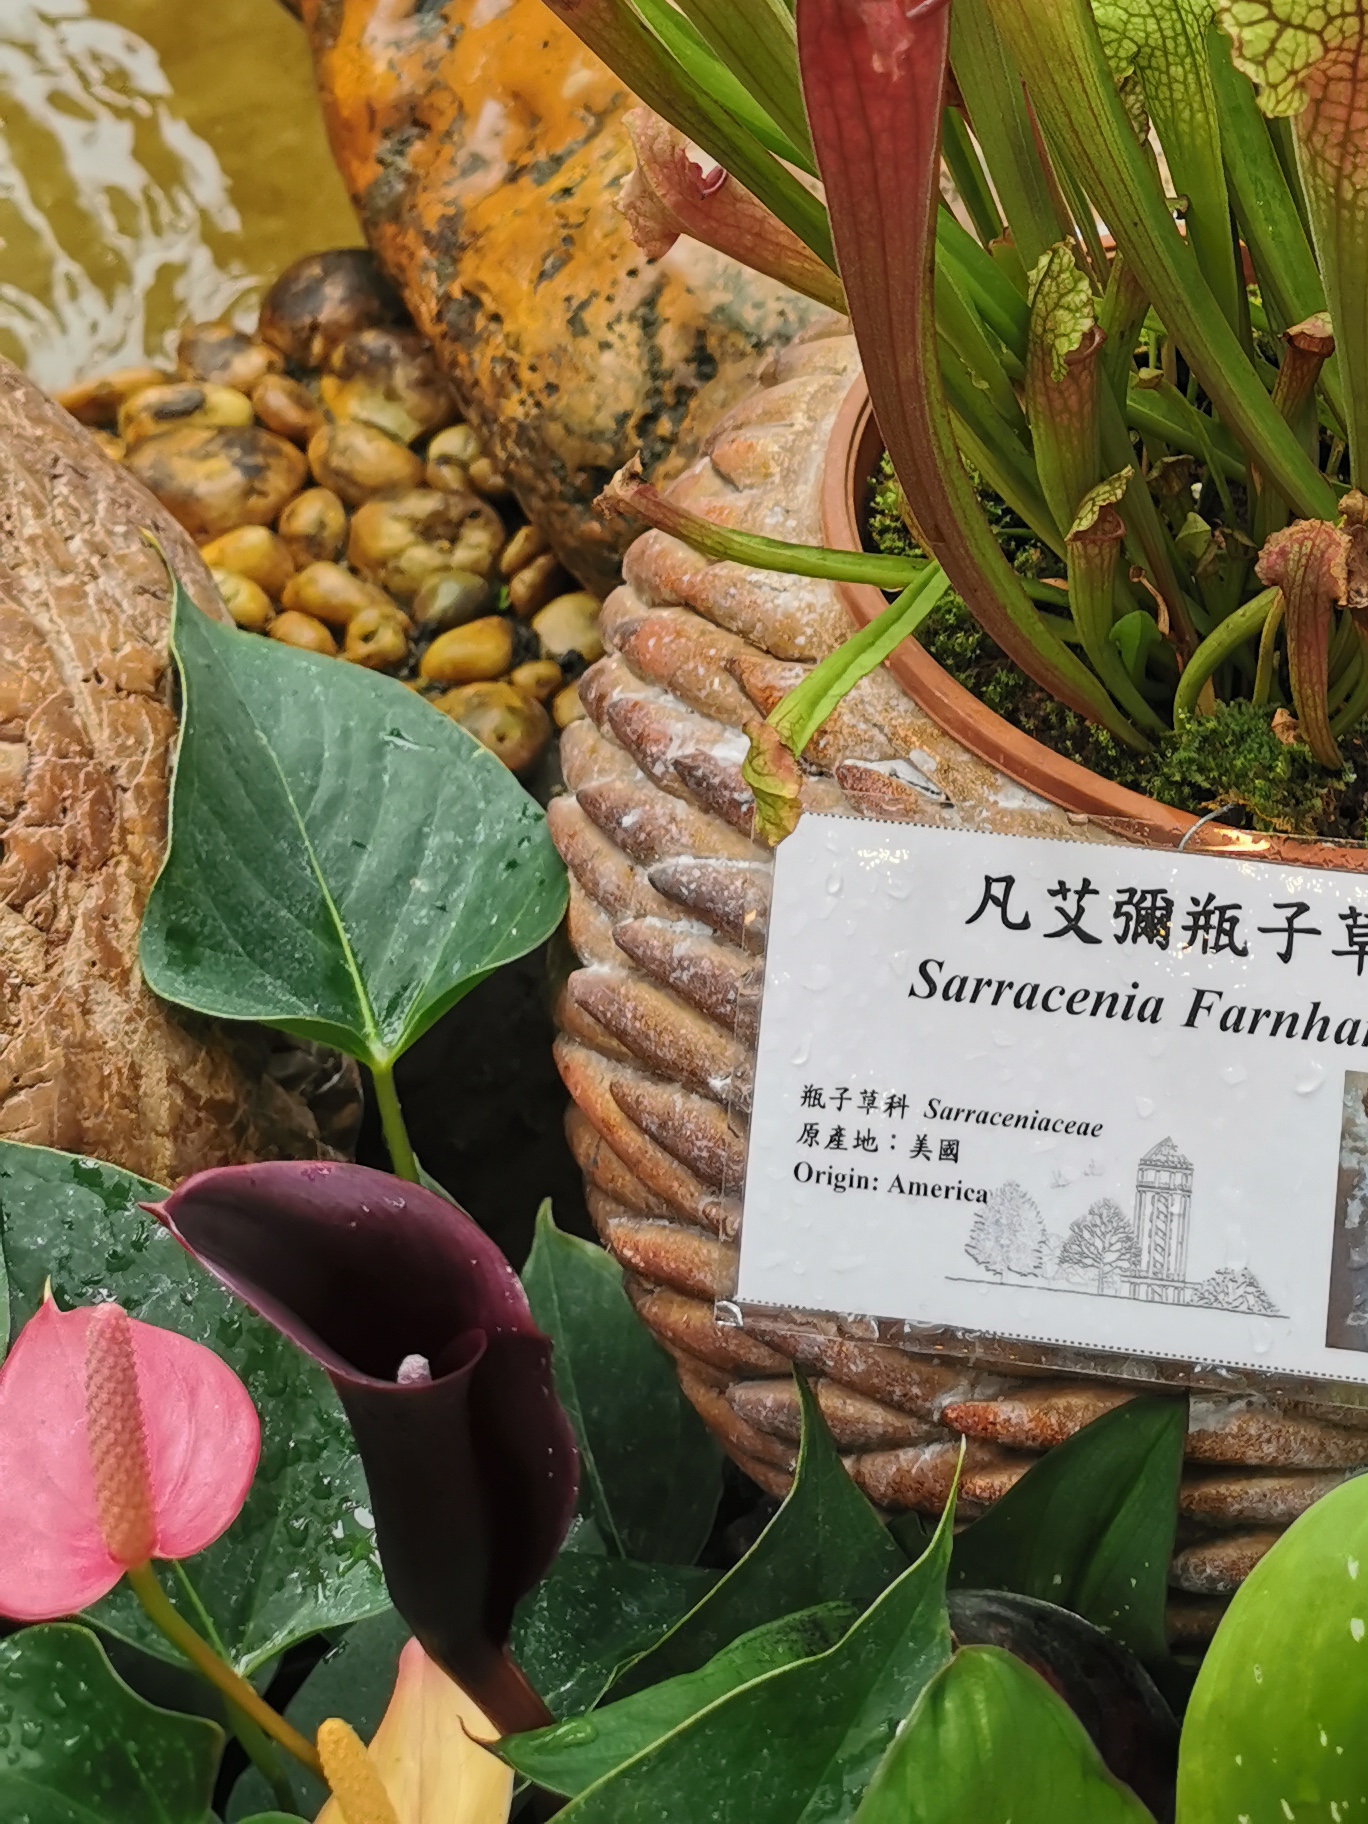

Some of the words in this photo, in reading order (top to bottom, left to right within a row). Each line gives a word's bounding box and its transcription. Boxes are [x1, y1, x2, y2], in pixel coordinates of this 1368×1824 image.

[909, 958, 1165, 1025] Sarracenia
[800, 1083, 911, 1120] 瓶子草科
[924, 1097, 1104, 1138] Sarraceniaceae
[793, 1161, 879, 1194] Origin:
[888, 1174, 988, 1205] America
